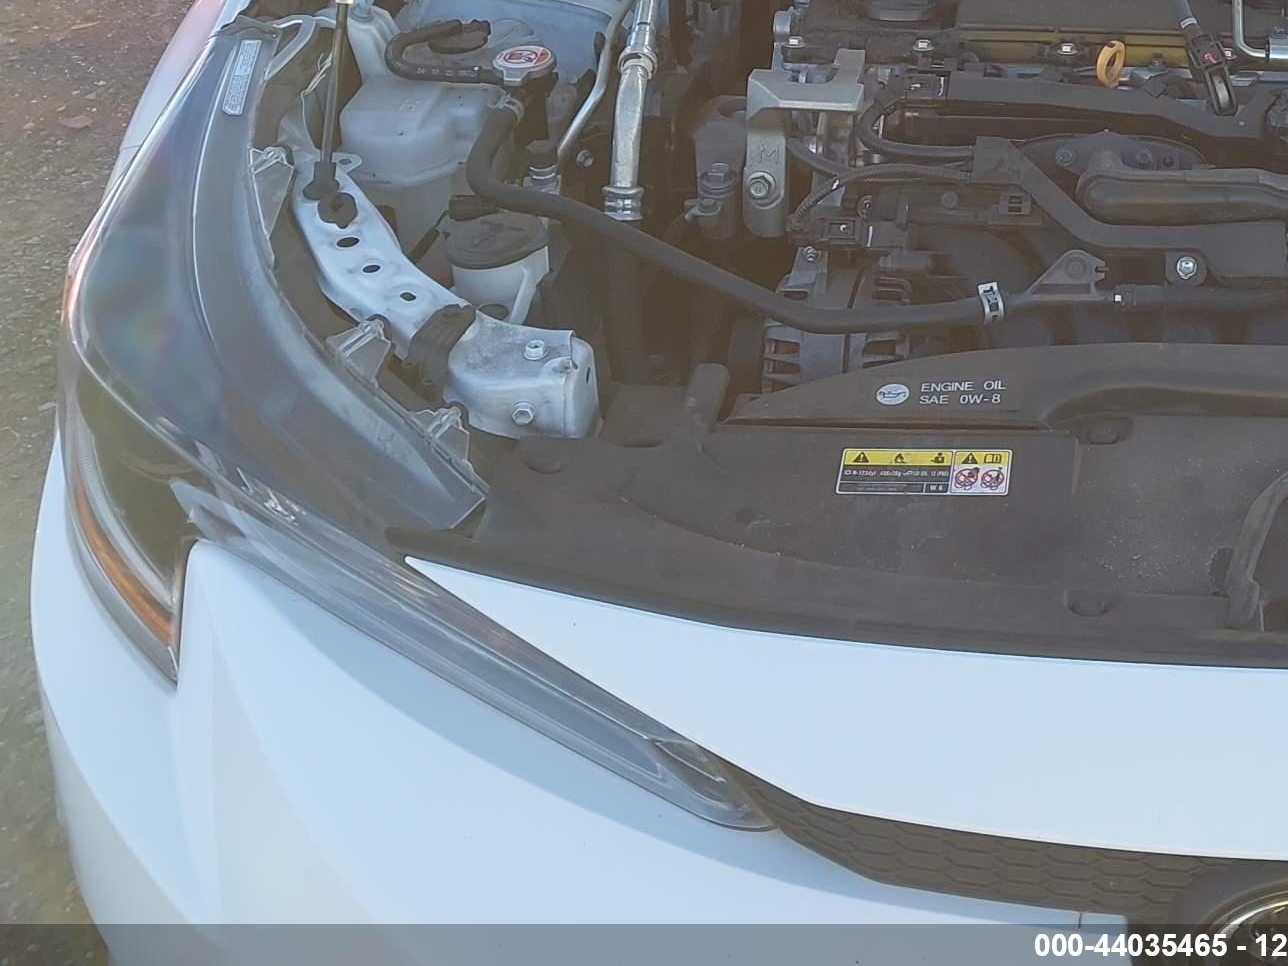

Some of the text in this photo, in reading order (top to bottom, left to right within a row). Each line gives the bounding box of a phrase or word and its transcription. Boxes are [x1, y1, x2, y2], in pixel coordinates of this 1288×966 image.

[920, 379, 1007, 393] ENGINE OIL
[919, 393, 1001, 405] SAE 0W-8
